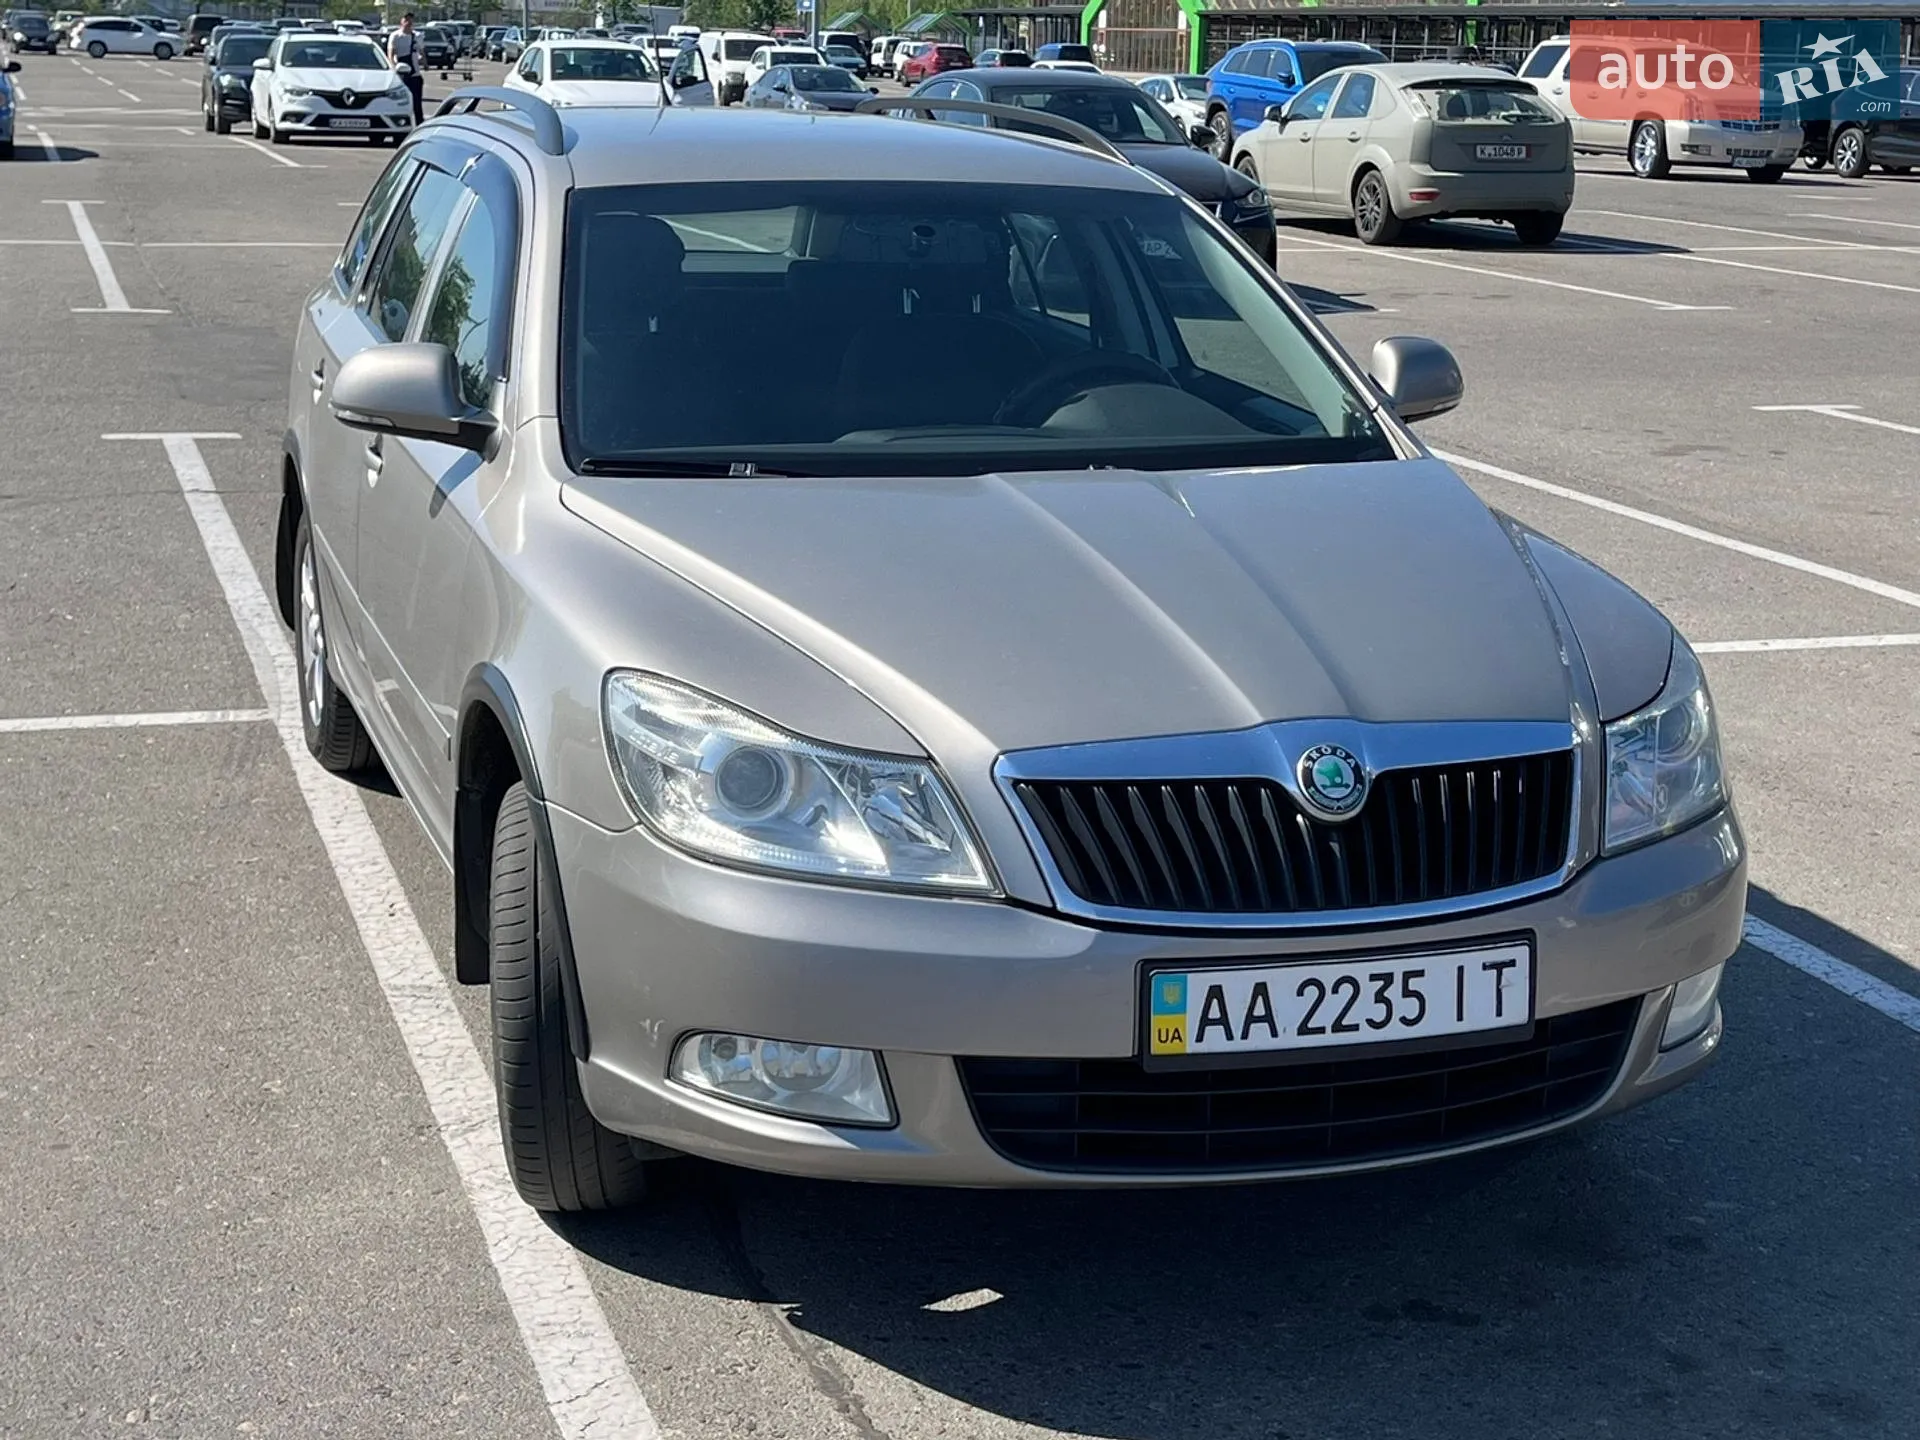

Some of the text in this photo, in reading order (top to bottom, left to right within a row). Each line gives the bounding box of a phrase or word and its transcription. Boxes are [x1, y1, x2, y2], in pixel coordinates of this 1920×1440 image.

[1194, 958, 1517, 1043] AA 2235 IT
[1157, 1028, 1184, 1045] UA
